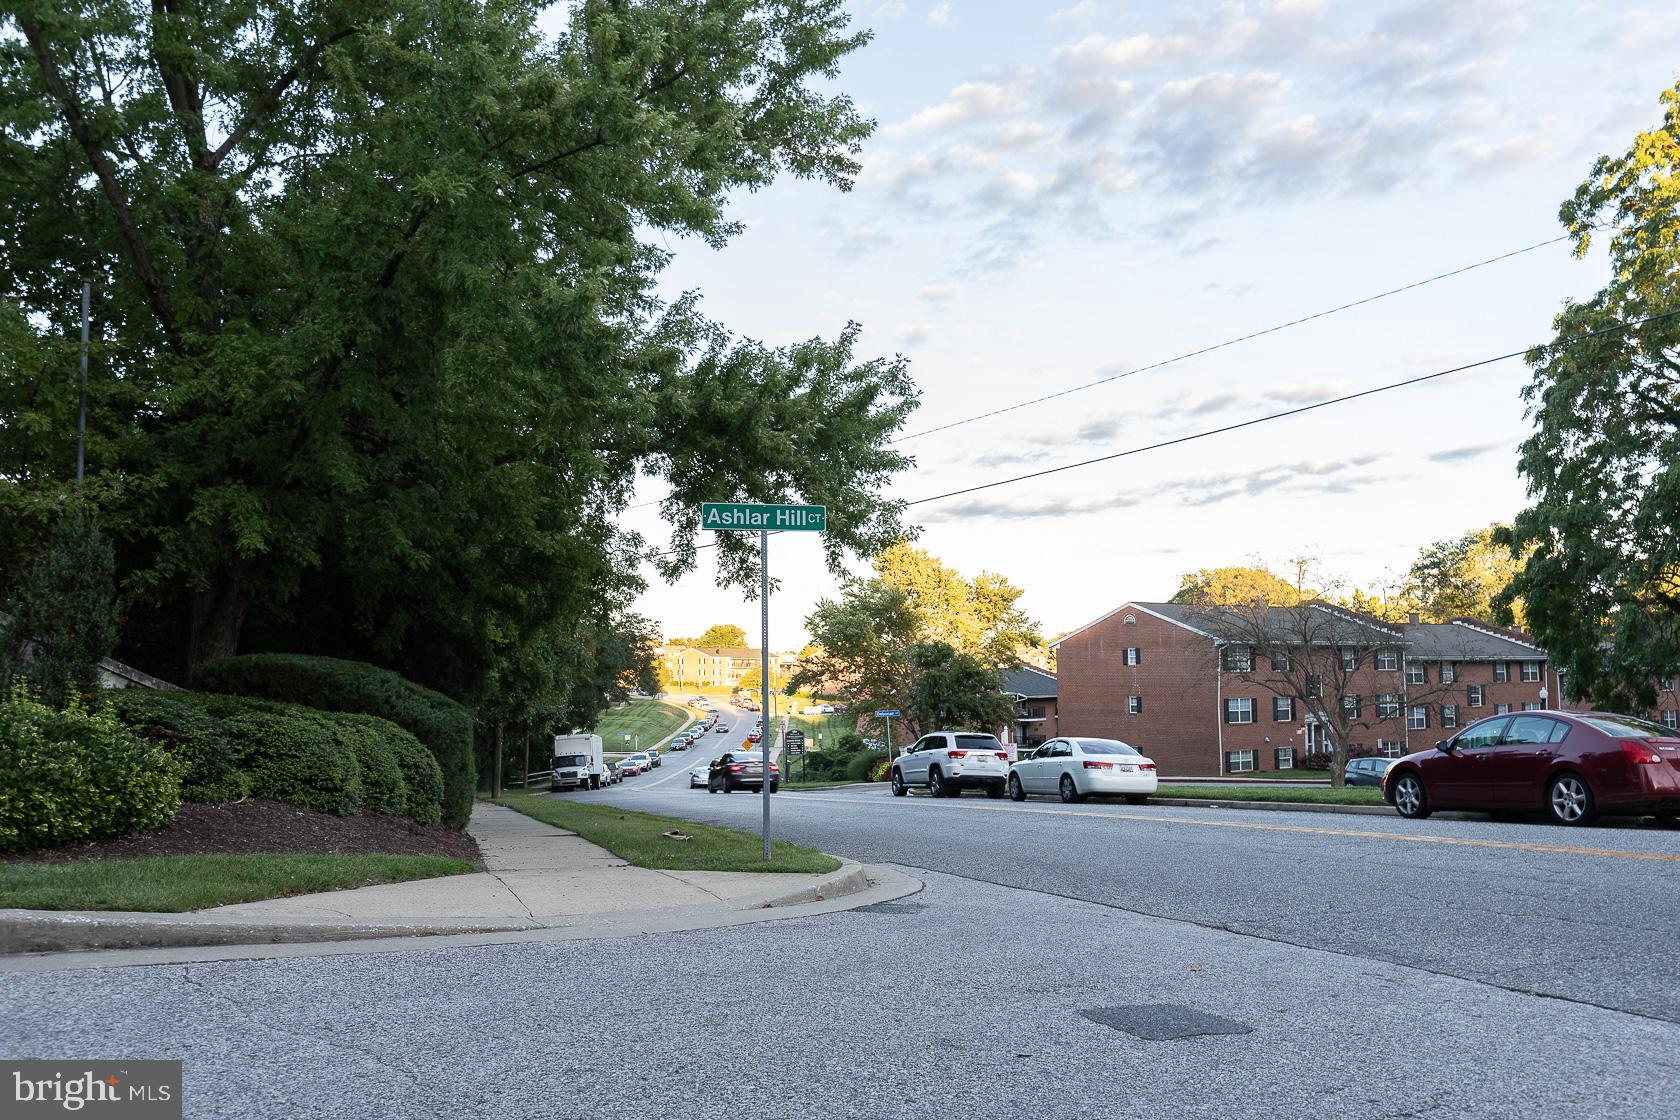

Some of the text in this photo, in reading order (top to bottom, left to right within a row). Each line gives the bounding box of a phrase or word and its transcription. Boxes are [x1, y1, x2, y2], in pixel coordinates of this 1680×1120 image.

[707, 508, 821, 526] Ashlar Hill CT
